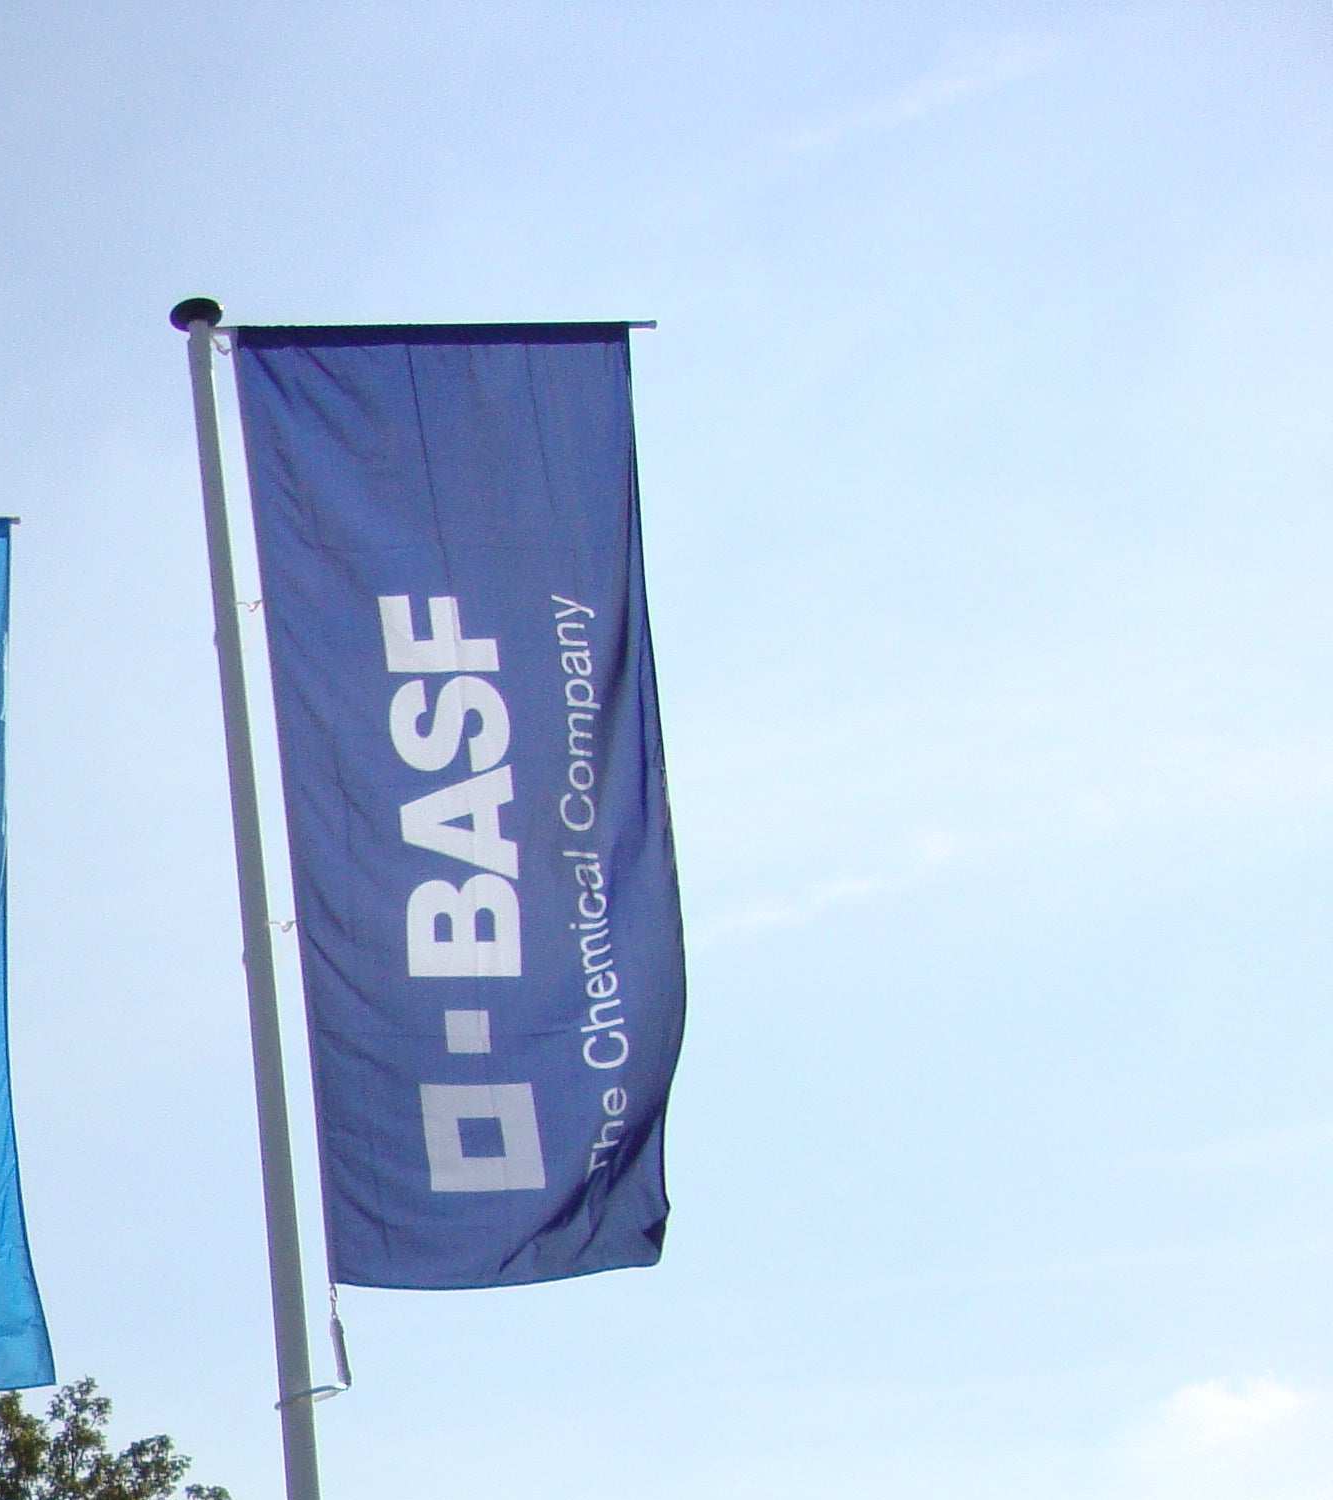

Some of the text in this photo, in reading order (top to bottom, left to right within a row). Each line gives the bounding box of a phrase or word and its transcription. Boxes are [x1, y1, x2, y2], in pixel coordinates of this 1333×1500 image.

[378, 593, 522, 978] BASF
[549, 594, 601, 833] Company
[563, 848, 630, 1071] Chemical
